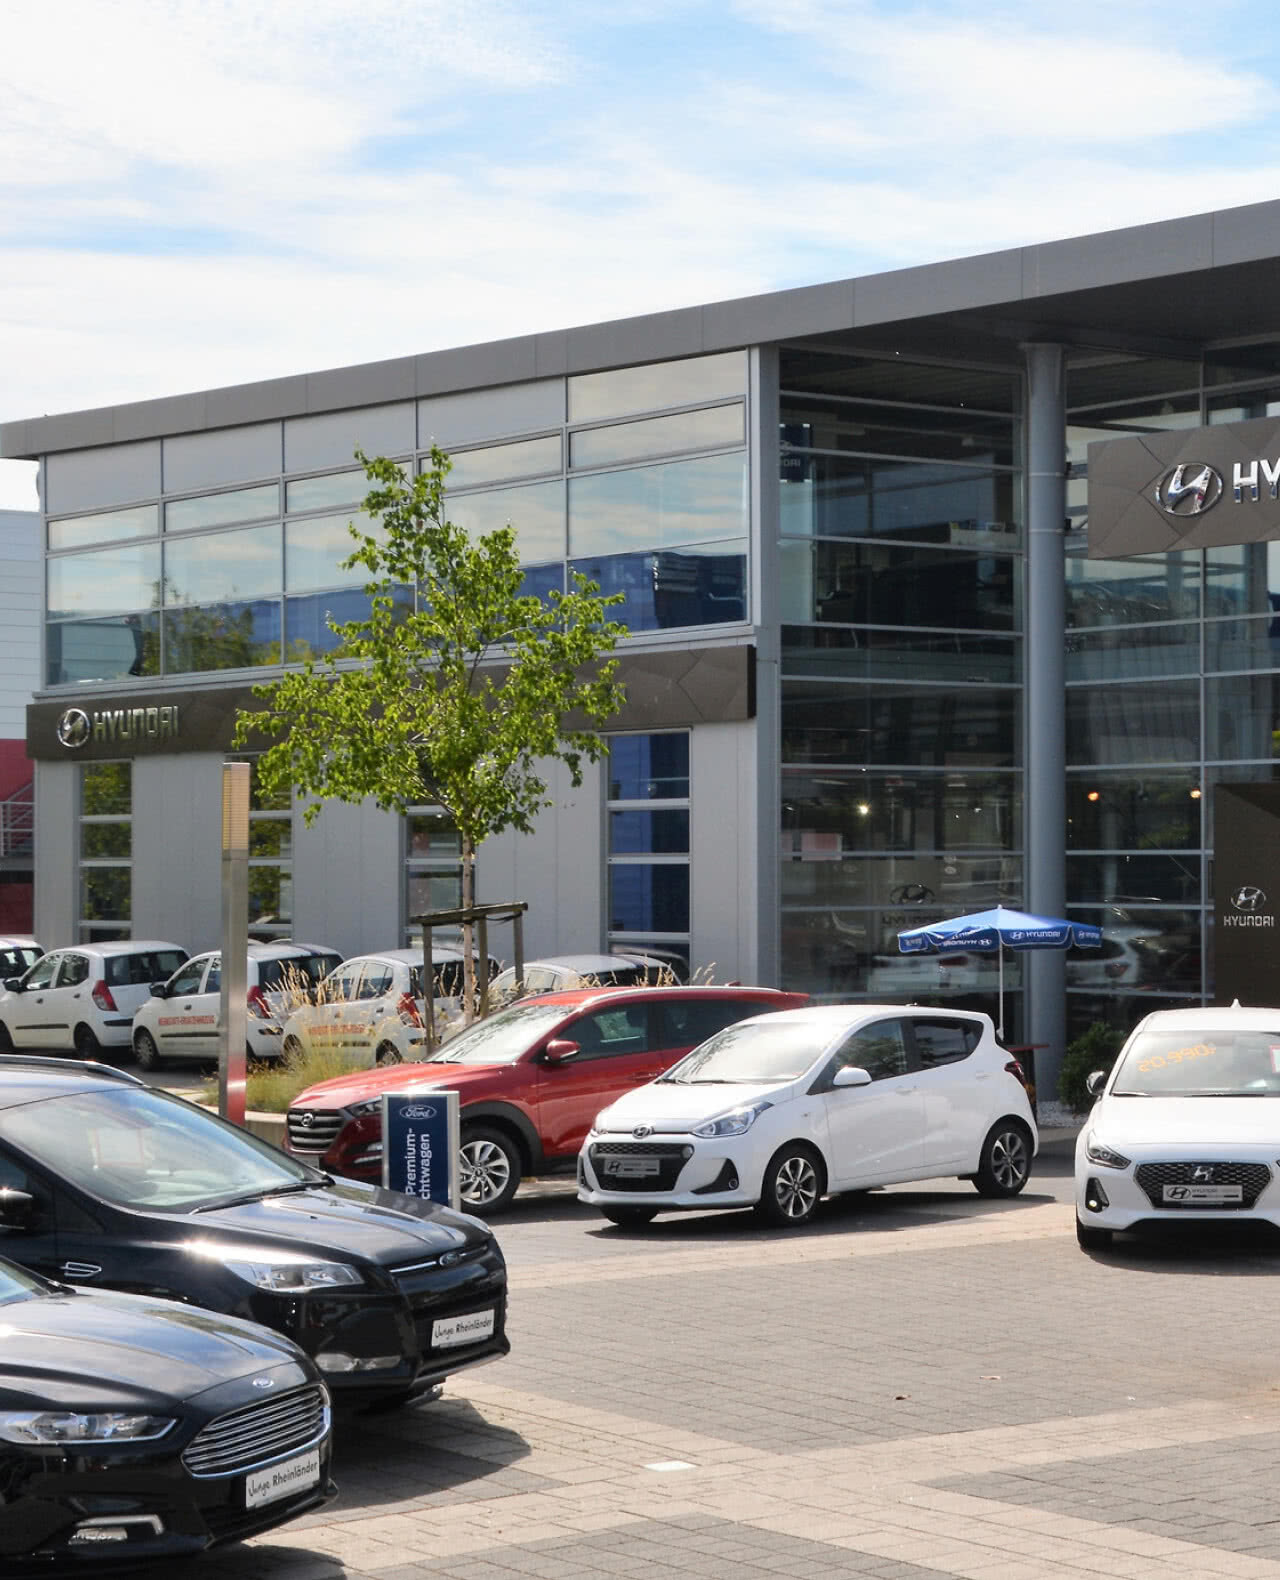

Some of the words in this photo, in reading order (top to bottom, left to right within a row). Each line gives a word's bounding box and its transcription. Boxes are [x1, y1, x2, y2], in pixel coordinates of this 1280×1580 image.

[93, 705, 178, 740] HYUNDAI
[1223, 915, 1275, 927] HYUNDAI
[404, 1128, 417, 1196] Premium-
[272, 1460, 318, 1486] Rheinländer
